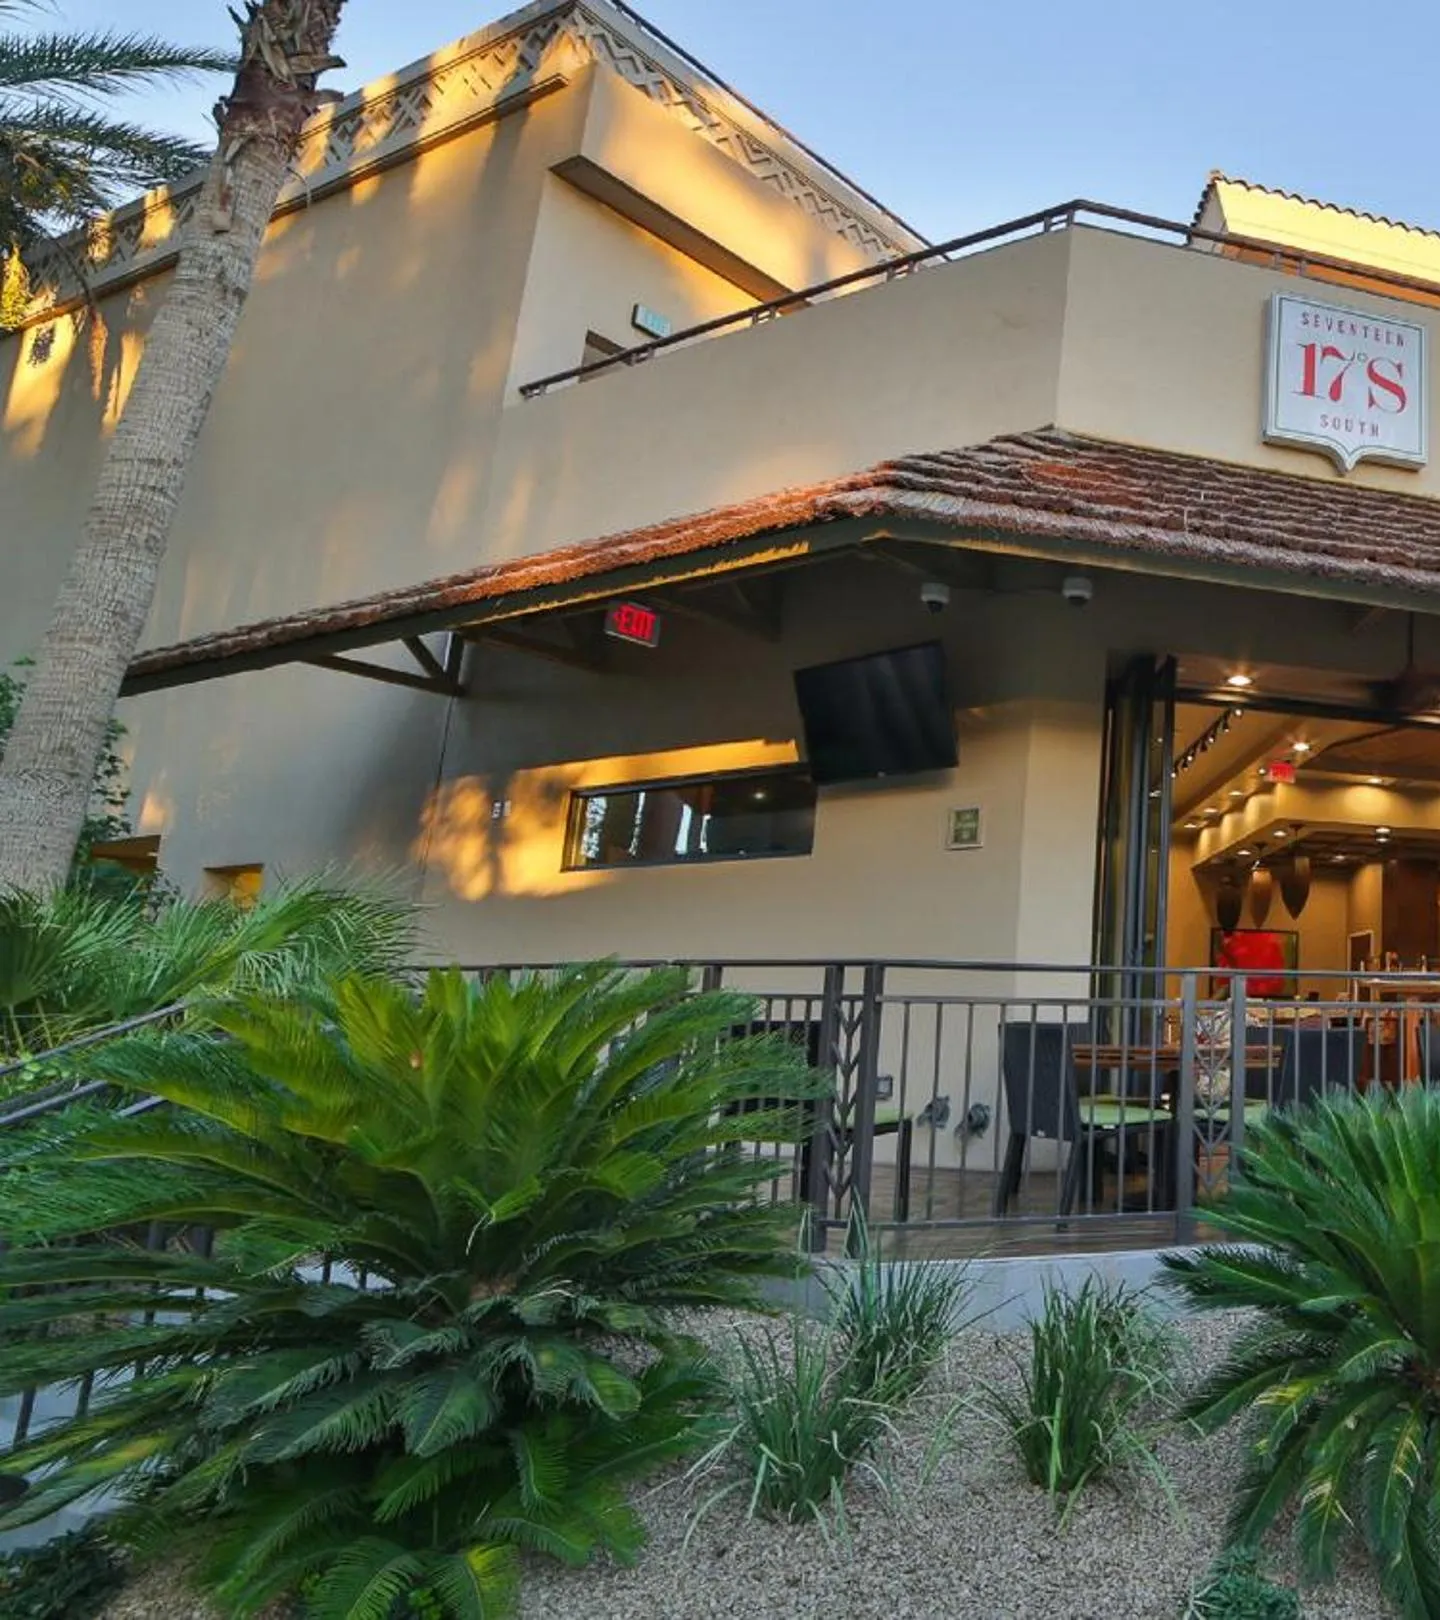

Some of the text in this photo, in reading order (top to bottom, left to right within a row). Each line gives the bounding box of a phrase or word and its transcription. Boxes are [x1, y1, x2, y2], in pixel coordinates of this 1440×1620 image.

[1301, 311, 1405, 348] SEVENTEEN
[1318, 413, 1380, 437] SOUTH
[617, 603, 657, 640] EXIT
